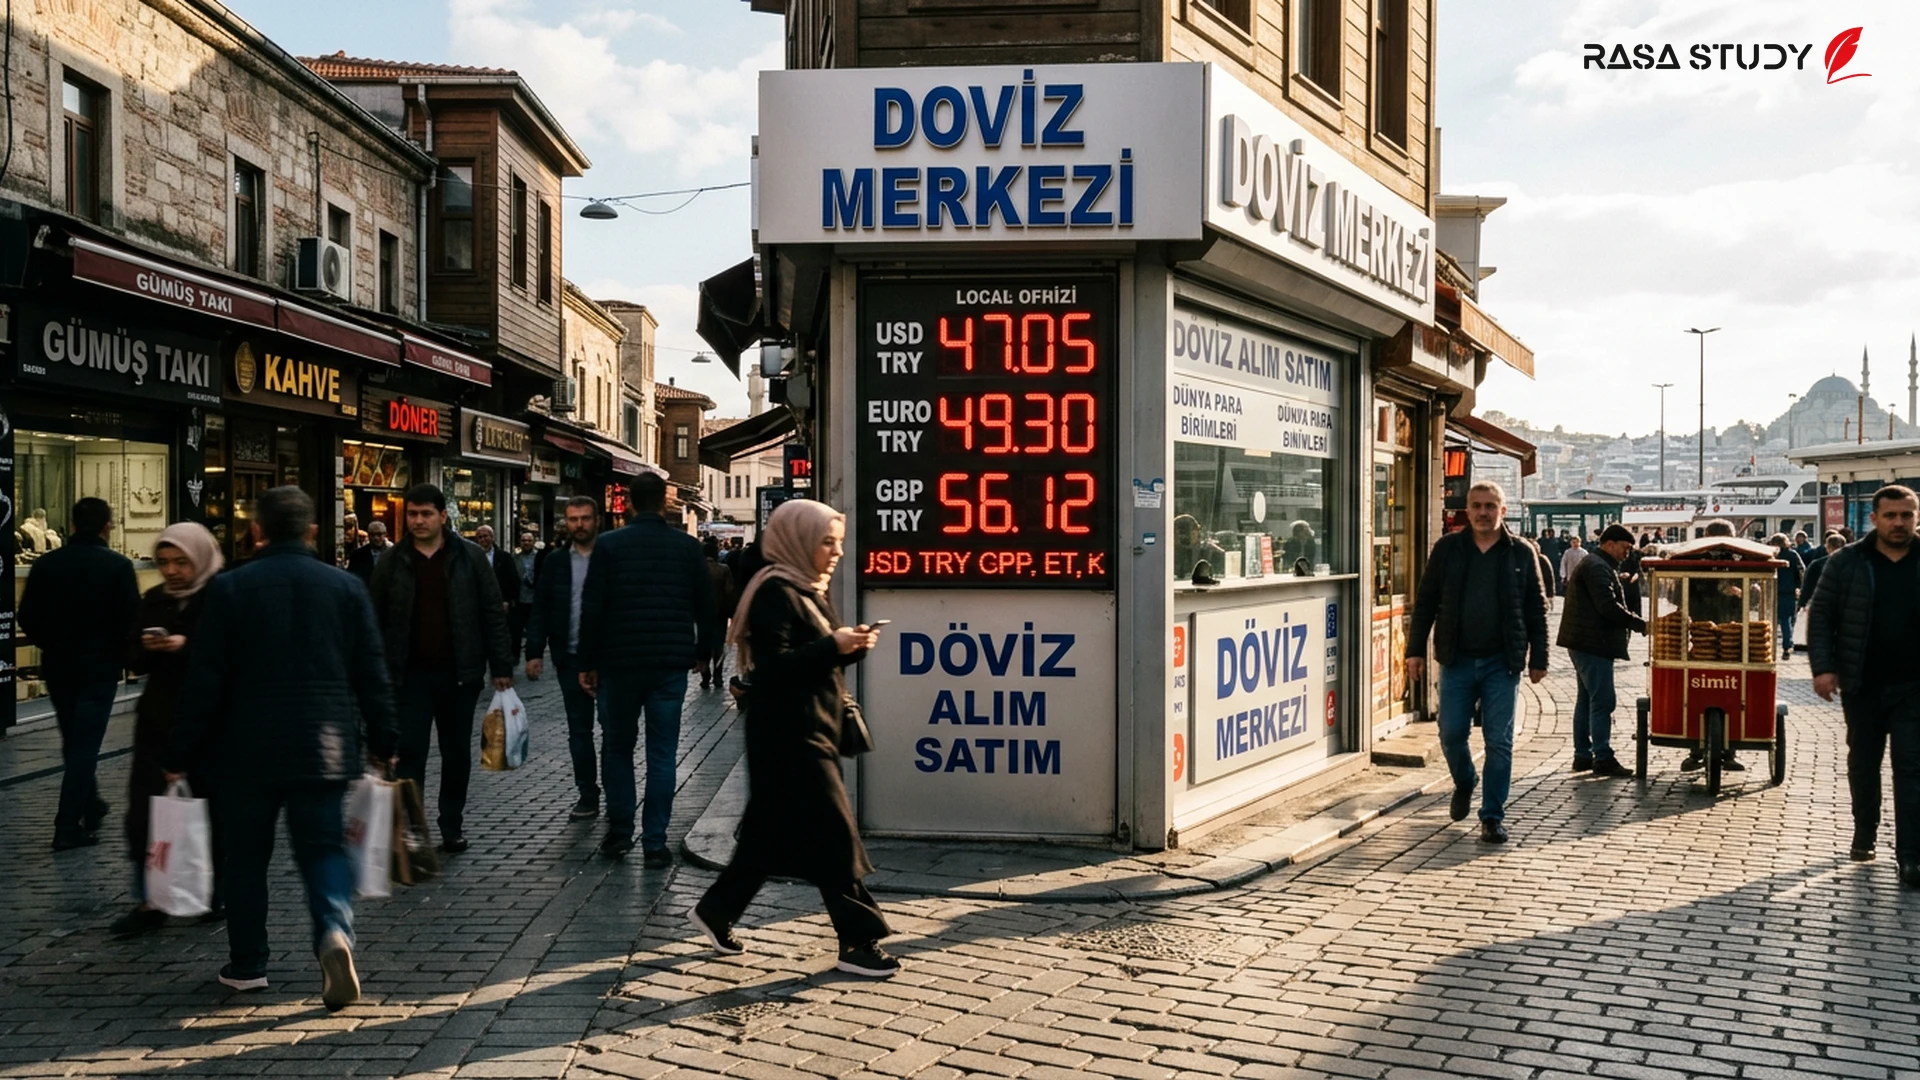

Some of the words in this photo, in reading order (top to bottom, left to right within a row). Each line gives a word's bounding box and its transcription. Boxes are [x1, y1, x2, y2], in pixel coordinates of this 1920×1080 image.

[873, 68, 1085, 150] DOVİZ
[822, 147, 1134, 230] MERKEZİ
[1219, 113, 1326, 251] DOVİZ
[1326, 181, 1432, 306] MERKEZİ
[199, 290, 233, 314] TAKI
[43, 317, 148, 386] GÜMÜŞ
[155, 343, 210, 388] TAKI
[876, 322, 923, 345] USD
[939, 313, 1095, 373] 47.05
[877, 352, 923, 374] TRY
[1238, 337, 1280, 380] ALIM
[1285, 350, 1332, 392] SATIM
[264, 353, 341, 403] KAHVE
[1174, 382, 1212, 411] DÜNYA
[1215, 393, 1243, 415] PARA
[868, 400, 932, 423] EURO
[939, 393, 1095, 453] 49.30
[877, 430, 923, 453] TRY
[1181, 412, 1237, 441] BİRİMLERİ
[876, 479, 924, 502] GBP
[939, 473, 1095, 533] 56.12
[877, 509, 923, 532] TRY
[919, 552, 971, 574] TRY
[900, 621, 1076, 678] DÖVİZ
[1217, 611, 1308, 700] DÖVİZ
[1691, 673, 1738, 690] simit
[928, 690, 1046, 726] ALIM
[1217, 684, 1307, 762] MERKEZİ
[914, 737, 1061, 775] SATIM
